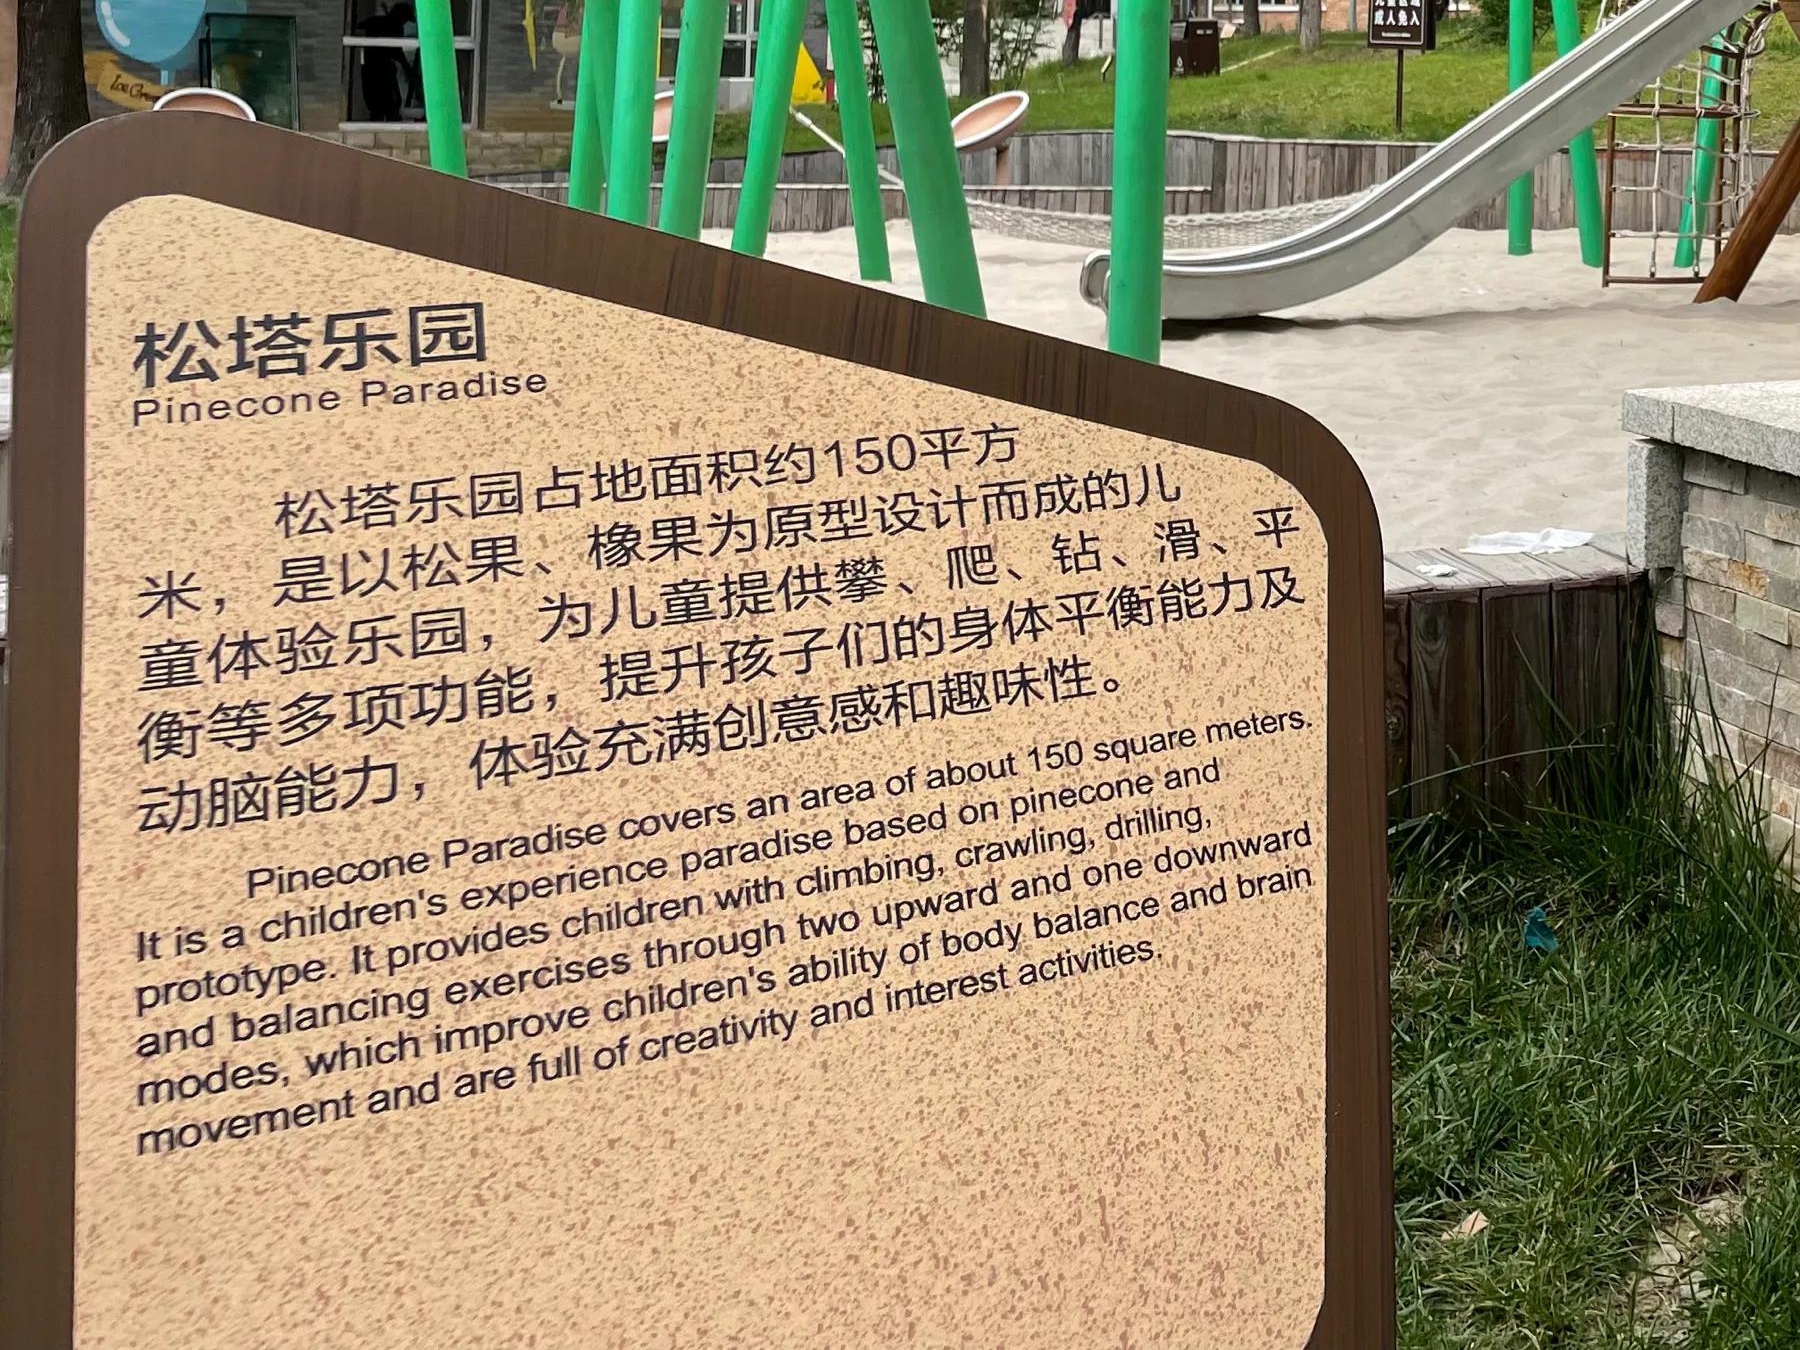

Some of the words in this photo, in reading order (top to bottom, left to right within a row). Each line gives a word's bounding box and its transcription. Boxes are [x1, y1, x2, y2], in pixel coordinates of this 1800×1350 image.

[133, 301, 487, 389] 松塔乐园
[133, 390, 341, 427] Pinecone
[361, 370, 547, 407] Paradise
[137, 462, 1181, 620] 米，是以松果、橡果为原型设计而成的儿
[274, 421, 1020, 539] 松塔乐园占地面积约150平方
[137, 506, 1300, 692] 童体验乐园，为儿童提供攀、爬、钻、滑、平
[137, 565, 1306, 765] 衡等多项功能，提升孩子们的身体平衡能力及
[136, 653, 1120, 835] 动脑能力，体验充满创意感和趣味性。
[247, 852, 430, 899] Pinecone
[443, 823, 607, 869] Paradise
[618, 803, 736, 841] covers
[746, 794, 789, 820] an
[800, 780, 876, 811] area
[885, 765, 917, 797] of
[926, 751, 1019, 790] about
[1027, 739, 1084, 772] 150
[1093, 728, 1197, 764] square
[1205, 711, 1313, 744] meters.
[135, 959, 337, 1018] prototype.
[352, 944, 377, 975] It
[387, 921, 550, 977] provides
[561, 895, 704, 938] children
[713, 875, 785, 911] with
[796, 853, 944, 897] climbing,
[955, 826, 1095, 868] crawling,
[1104, 805, 1211, 841] drilling,
[135, 1015, 214, 1058] and
[231, 987, 429, 1042] balancing
[445, 952, 631, 1005] exercises
[643, 918, 786, 969] through
[796, 910, 860, 940] two
[872, 877, 999, 930] upward
[1010, 863, 1072, 901] and
[1083, 858, 1143, 887] one
[1153, 820, 1312, 873] downward
[137, 931, 162, 963] It
[175, 926, 207, 957] is
[221, 925, 245, 949] a
[260, 888, 448, 943] children's
[460, 857, 668, 911] experience
[680, 828, 833, 882] paradise
[844, 802, 947, 846] based
[958, 801, 999, 825] on
[1010, 774, 1154, 824] pinecone
[1164, 756, 1221, 790] and
[137, 1060, 289, 1107] modes,
[304, 1030, 421, 1078] which
[433, 1006, 590, 1055] improve
[603, 965, 777, 1022] children's
[788, 945, 888, 987] ability
[899, 932, 932, 965] of
[941, 919, 1023, 957] body
[1033, 896, 1160, 939] balance
[1170, 876, 1228, 913] and
[1236, 868, 1312, 900] brain
[137, 1089, 356, 1156] movement
[367, 1071, 440, 1115] and
[454, 1066, 517, 1098] are
[527, 1045, 581, 1084] full
[593, 1034, 630, 1071] of
[639, 1008, 799, 1061] creativity
[810, 987, 874, 1028] and
[885, 963, 1011, 1013] interest
[1018, 940, 1163, 986] activities.
